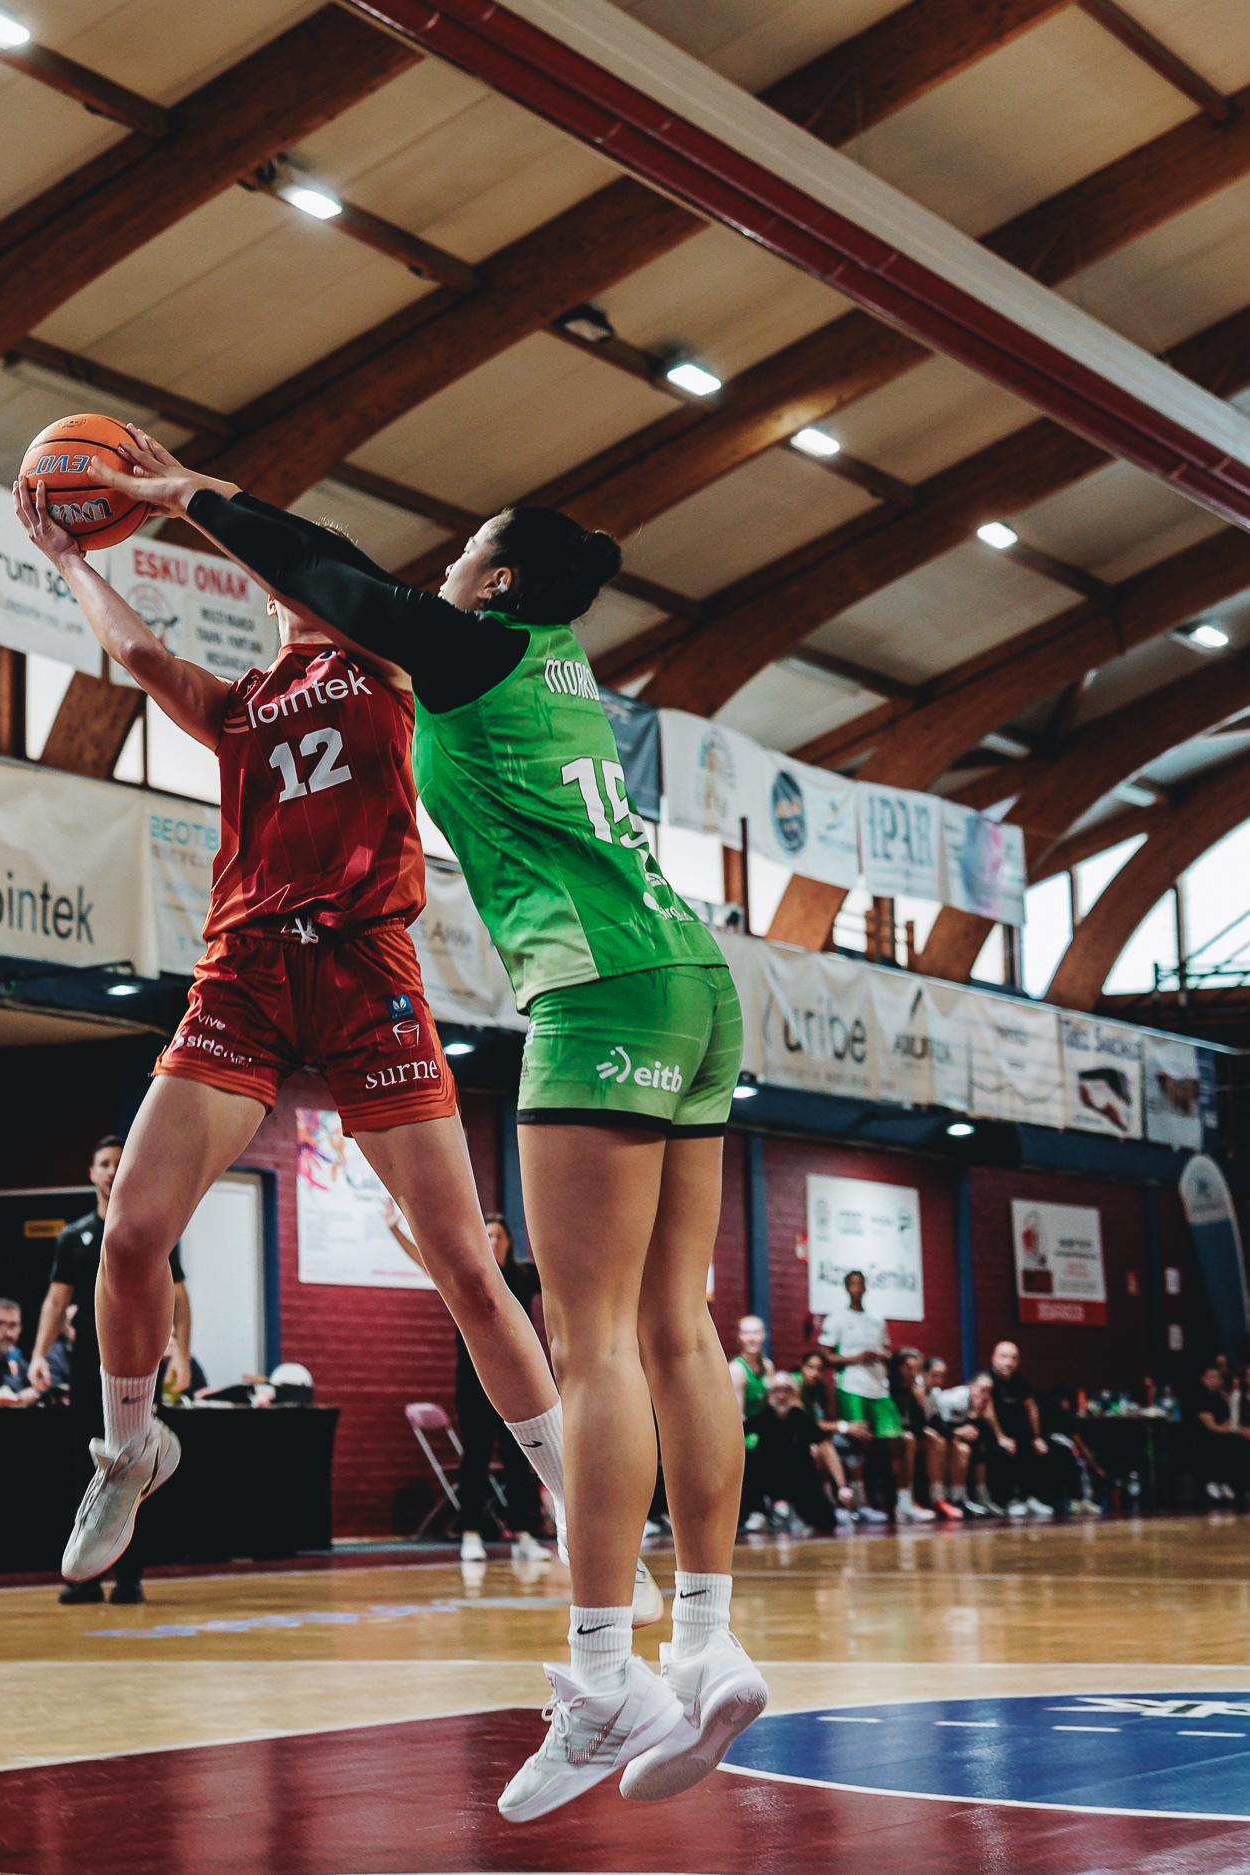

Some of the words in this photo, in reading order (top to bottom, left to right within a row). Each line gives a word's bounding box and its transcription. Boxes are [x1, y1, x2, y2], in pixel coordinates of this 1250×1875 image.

[49, 497, 114, 526] Wils
[132, 549, 188, 587] ESKU
[194, 565, 249, 603] ONAK
[246, 669, 372, 729] lointek
[268, 727, 352, 803] 12
[560, 756, 649, 849] 15
[198, 1014, 226, 1031] vive
[364, 1060, 440, 1091] surne
[634, 1061, 683, 1093] eitb
